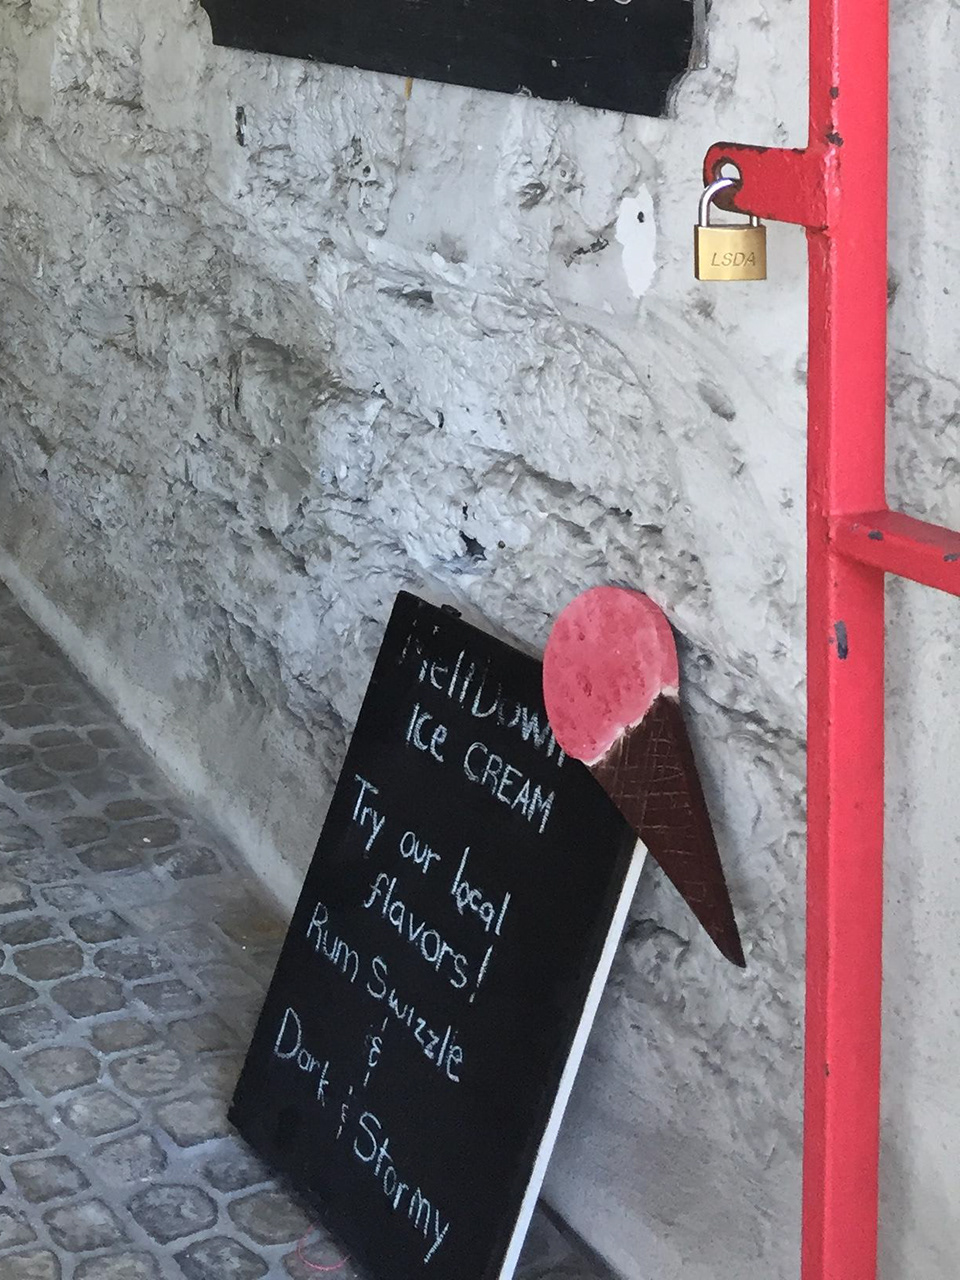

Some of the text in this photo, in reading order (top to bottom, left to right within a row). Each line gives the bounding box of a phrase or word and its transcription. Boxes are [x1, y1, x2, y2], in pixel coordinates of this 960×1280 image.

[711, 251, 757, 267] LSDA
[352, 773, 512, 937] Try our local
[463, 741, 556, 835] CREAM
[306, 901, 464, 1084] Rum Swizzle
[362, 872, 494, 1003] flavors!
[273, 1007, 330, 1108] Dark
[353, 1111, 450, 1265] Stormy
